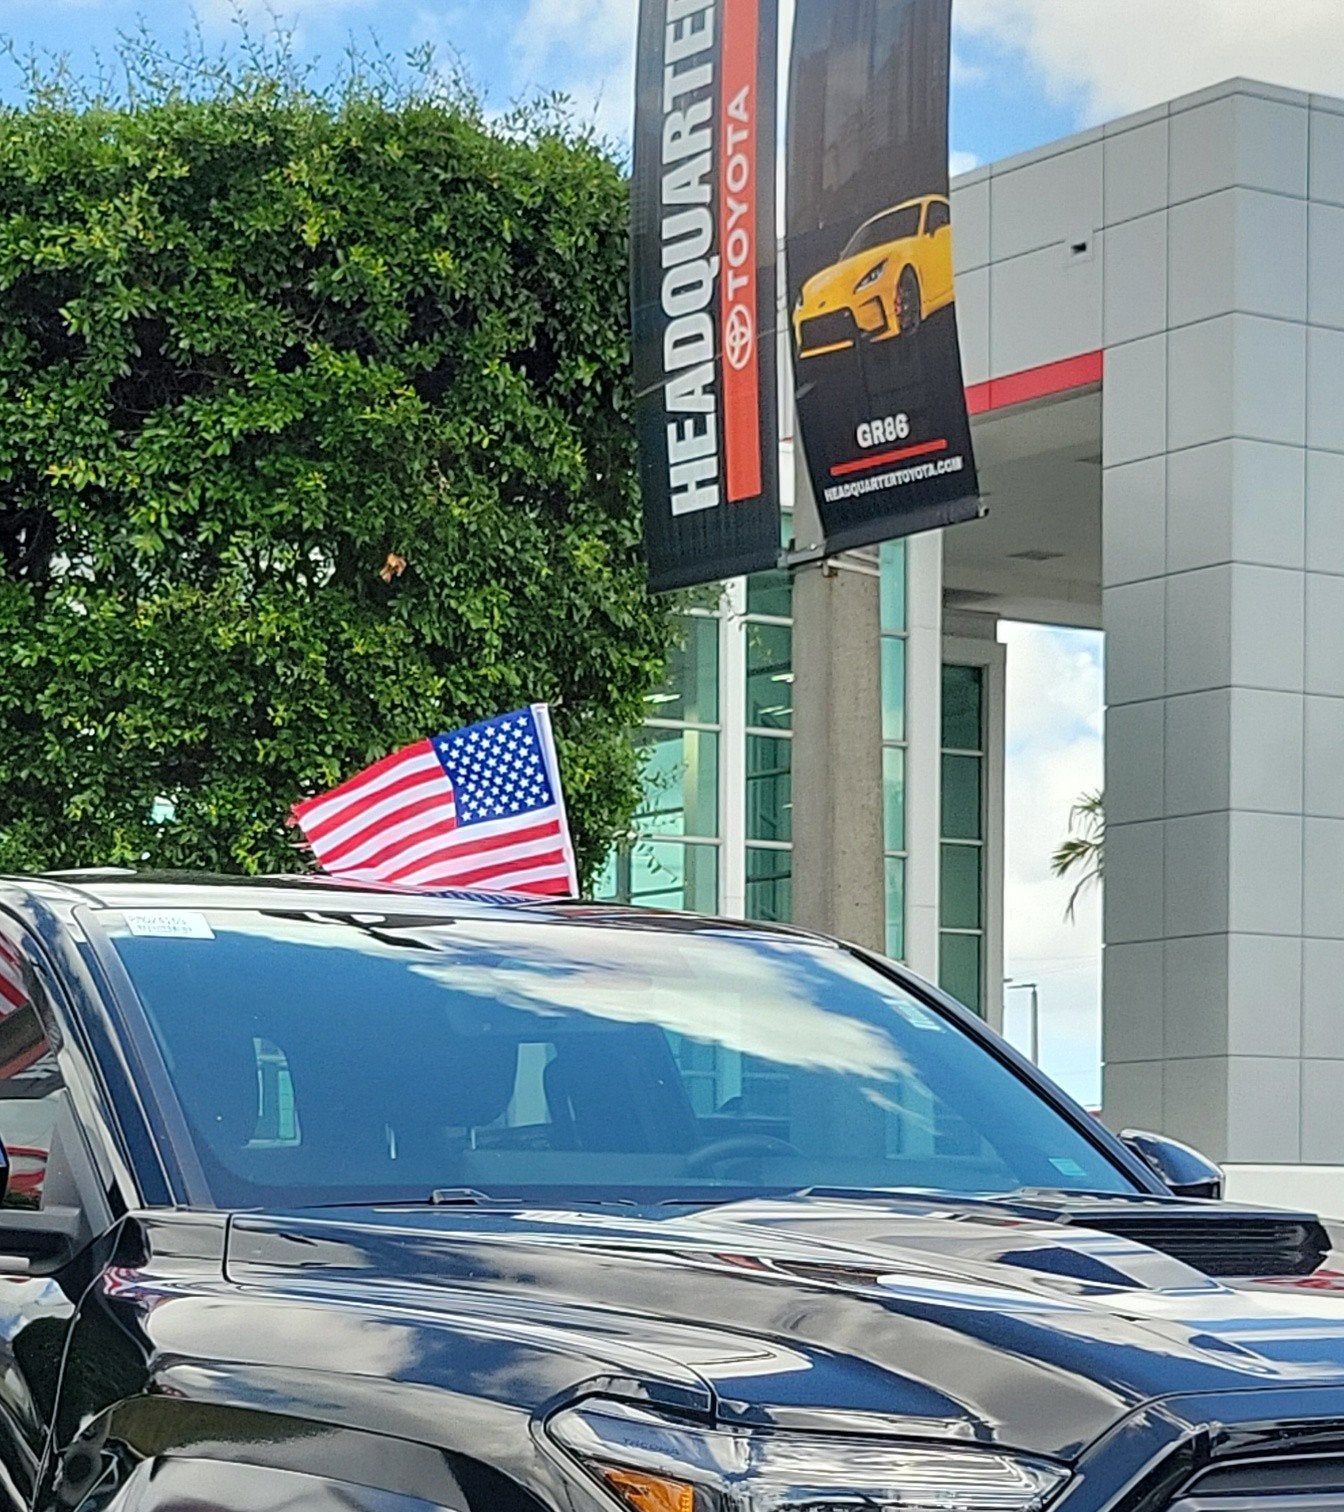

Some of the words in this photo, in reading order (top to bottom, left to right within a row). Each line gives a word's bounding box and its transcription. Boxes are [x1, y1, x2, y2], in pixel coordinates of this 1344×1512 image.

[660, 0, 719, 516] HEADQUARTE
[726, 85, 750, 302] TOYOTA
[824, 456, 964, 502] HEADQUARTERTOYOTA.COM
[856, 413, 910, 449] GR86
